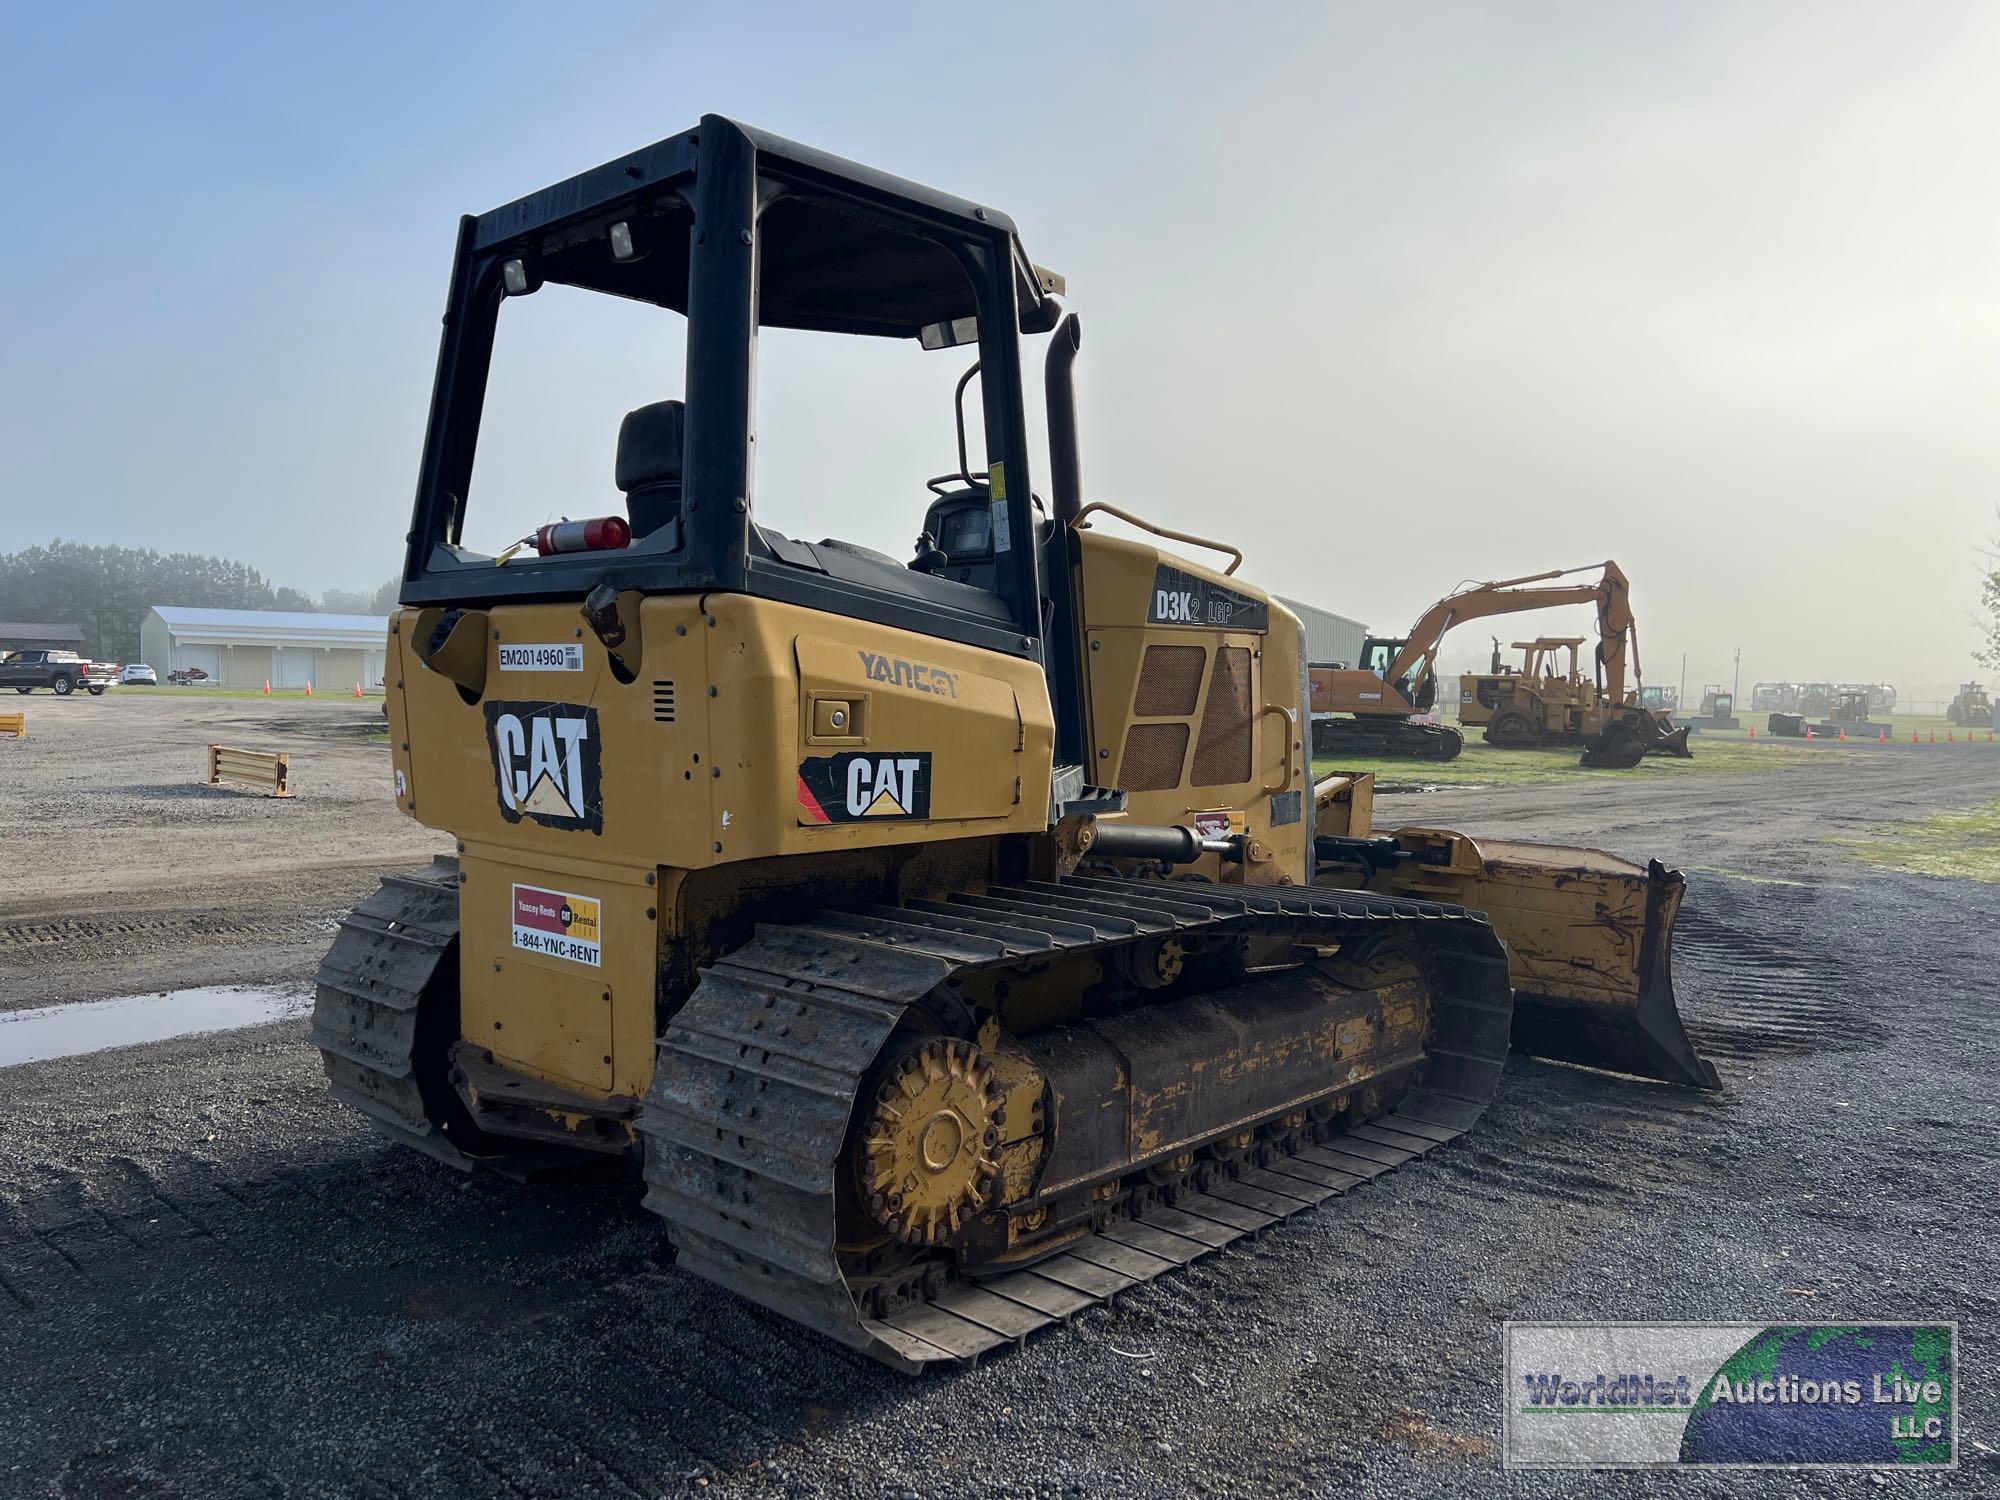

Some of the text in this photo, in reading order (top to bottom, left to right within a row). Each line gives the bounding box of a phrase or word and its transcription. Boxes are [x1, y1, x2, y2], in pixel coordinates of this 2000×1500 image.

[1156, 590, 1233, 623] D3K2 LGP
[500, 649, 564, 666] EM2014960
[496, 713, 588, 819] CAT
[846, 757, 920, 816] CAT
[518, 900, 556, 918] Yancey Rents
[573, 913, 597, 928] Rental
[513, 931, 599, 964] 1-844-YNC-RENT
